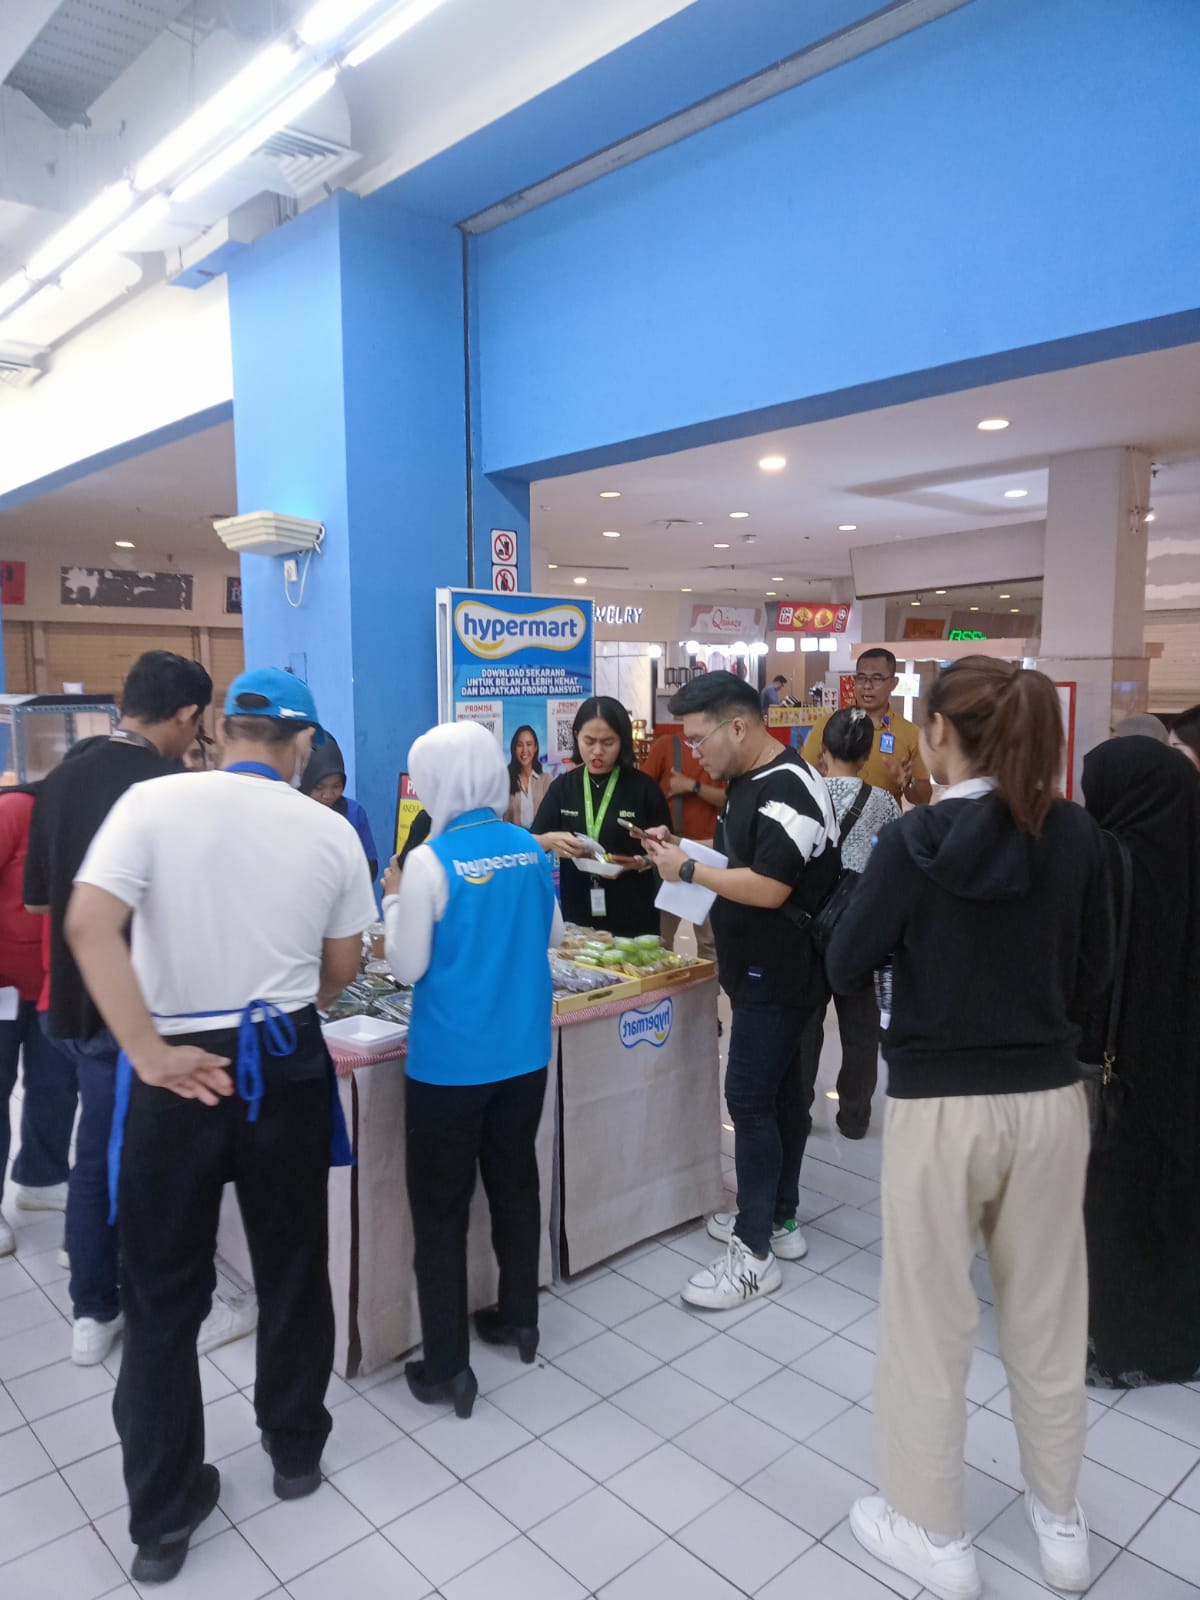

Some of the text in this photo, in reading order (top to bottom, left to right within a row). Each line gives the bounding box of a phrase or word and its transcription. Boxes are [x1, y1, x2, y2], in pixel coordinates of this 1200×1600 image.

[463, 612, 578, 641] hypermart
[481, 668, 566, 677] DOWNLOAD SEKARANG
[466, 676, 578, 687] UNTUK BELANJA LEBIH HEMAT
[461, 687, 478, 696] DAN
[480, 686, 520, 696] DAPATKAN
[521, 686, 548, 695] PROMO
